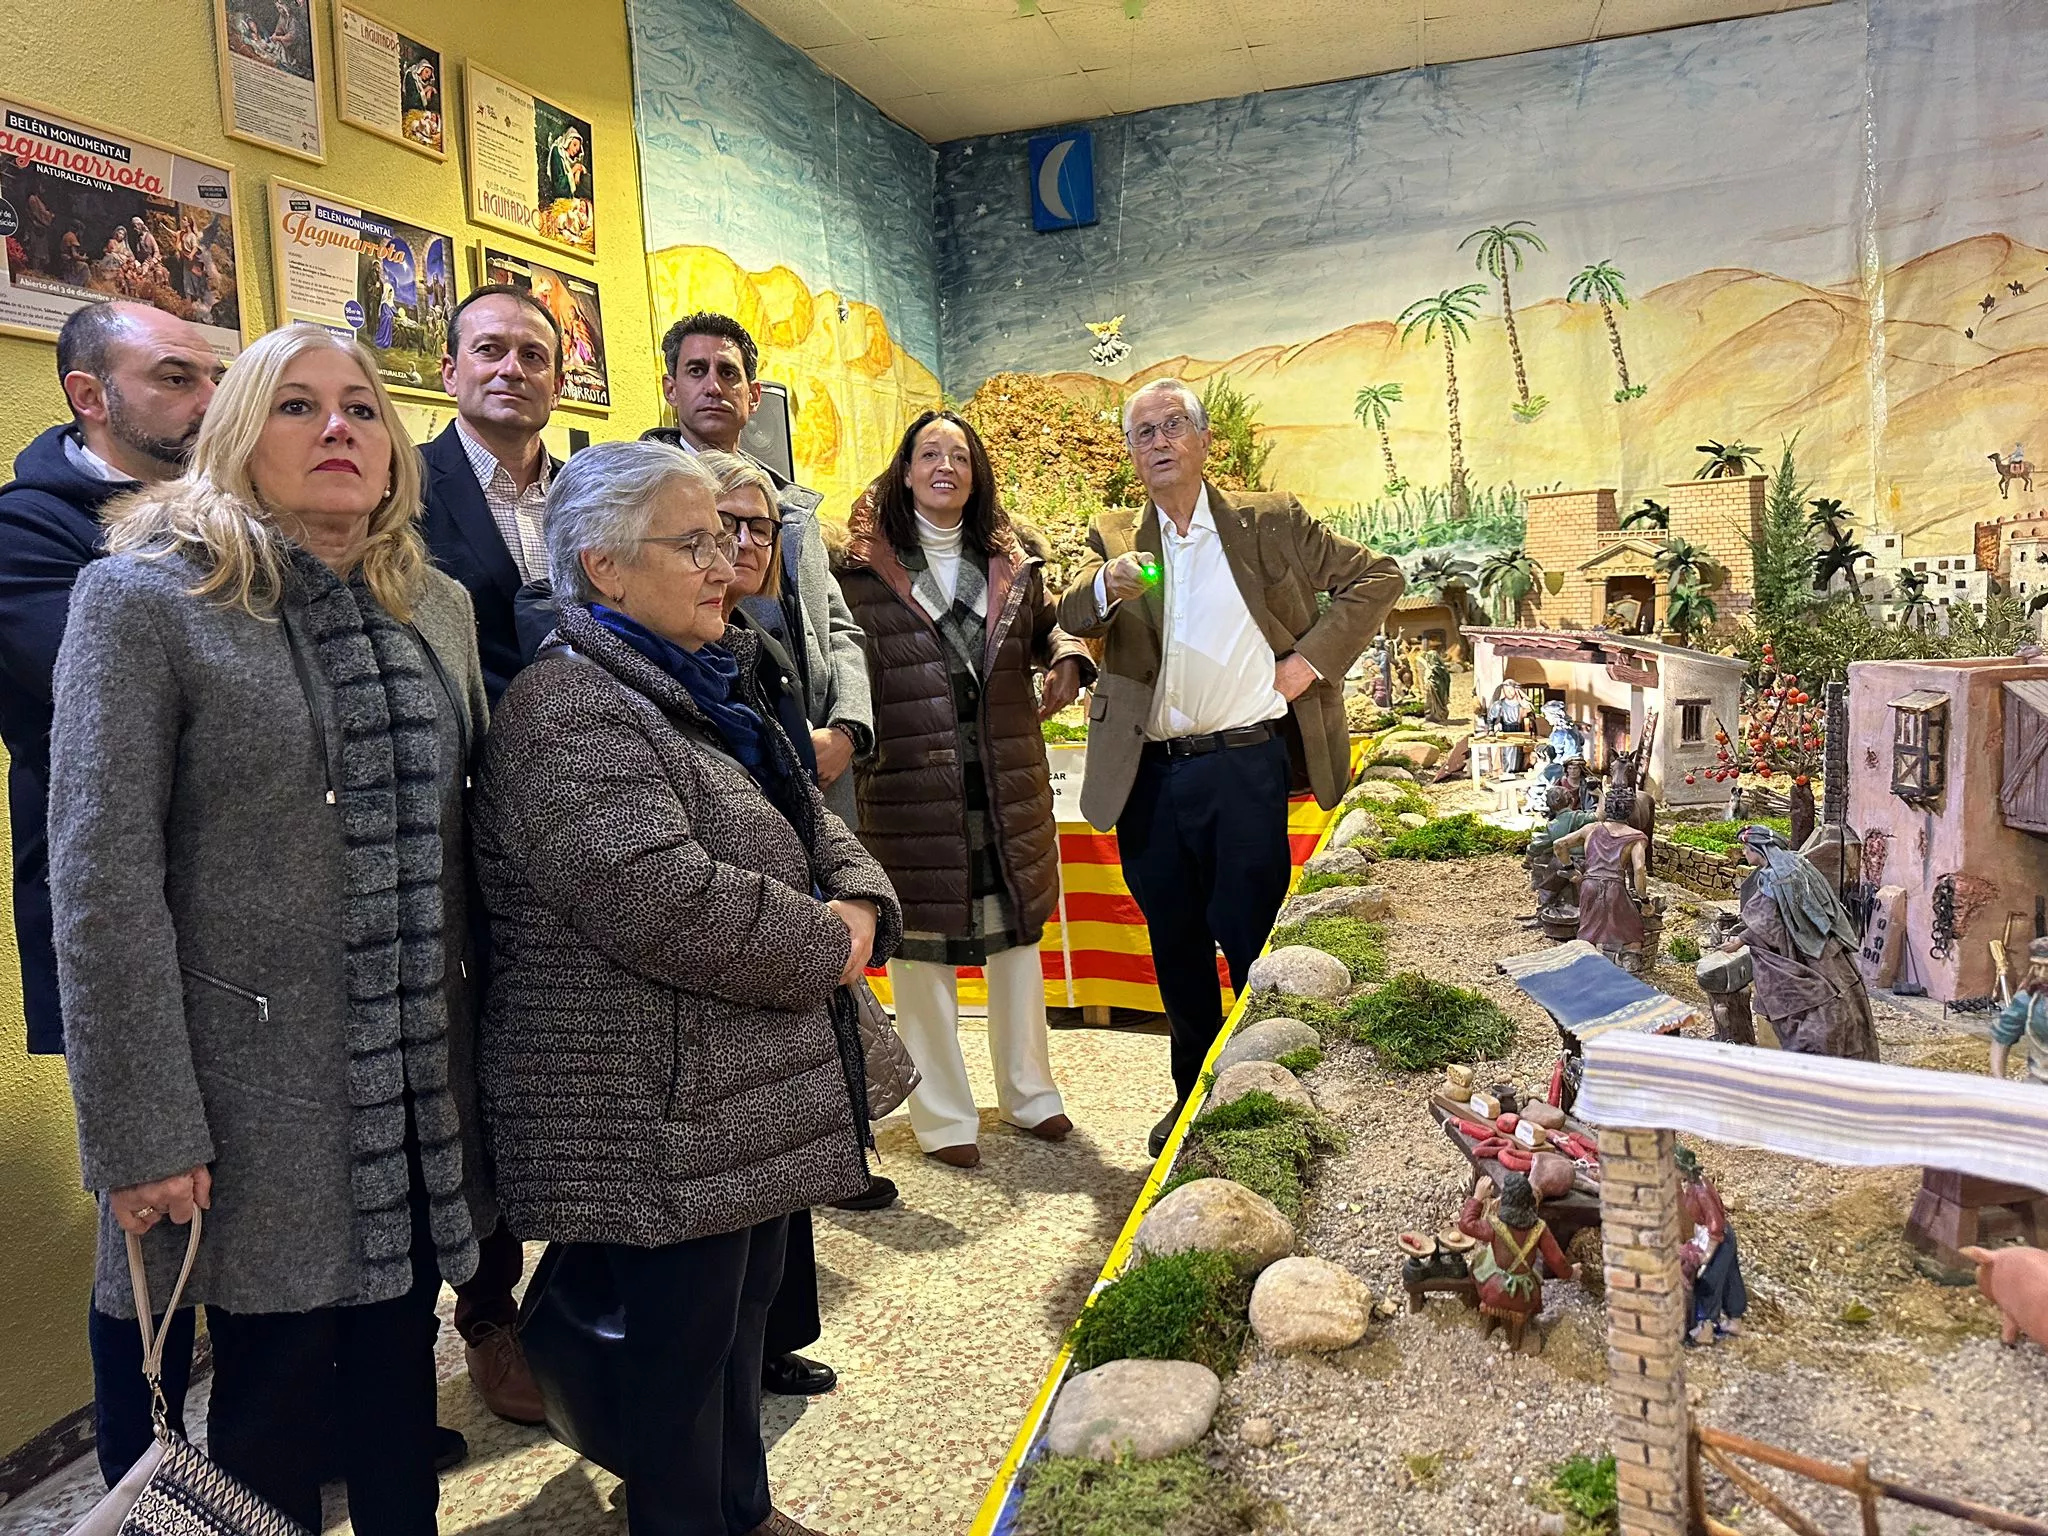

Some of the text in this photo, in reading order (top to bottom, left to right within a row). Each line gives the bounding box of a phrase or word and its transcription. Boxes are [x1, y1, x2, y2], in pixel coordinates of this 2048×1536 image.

[9, 114, 129, 161] BELÉN MONUMENTAL
[36, 164, 113, 193] NATURALEZA VIVA
[282, 212, 406, 264] Lagunarrota
[317, 208, 393, 238] BELÉN MONUMENTAL
[20, 277, 48, 290] Abierto
[48, 284, 60, 292] del
[60, 286, 66, 295] 3
[66, 288, 76, 296] de
[76, 289, 110, 302] diciembre
